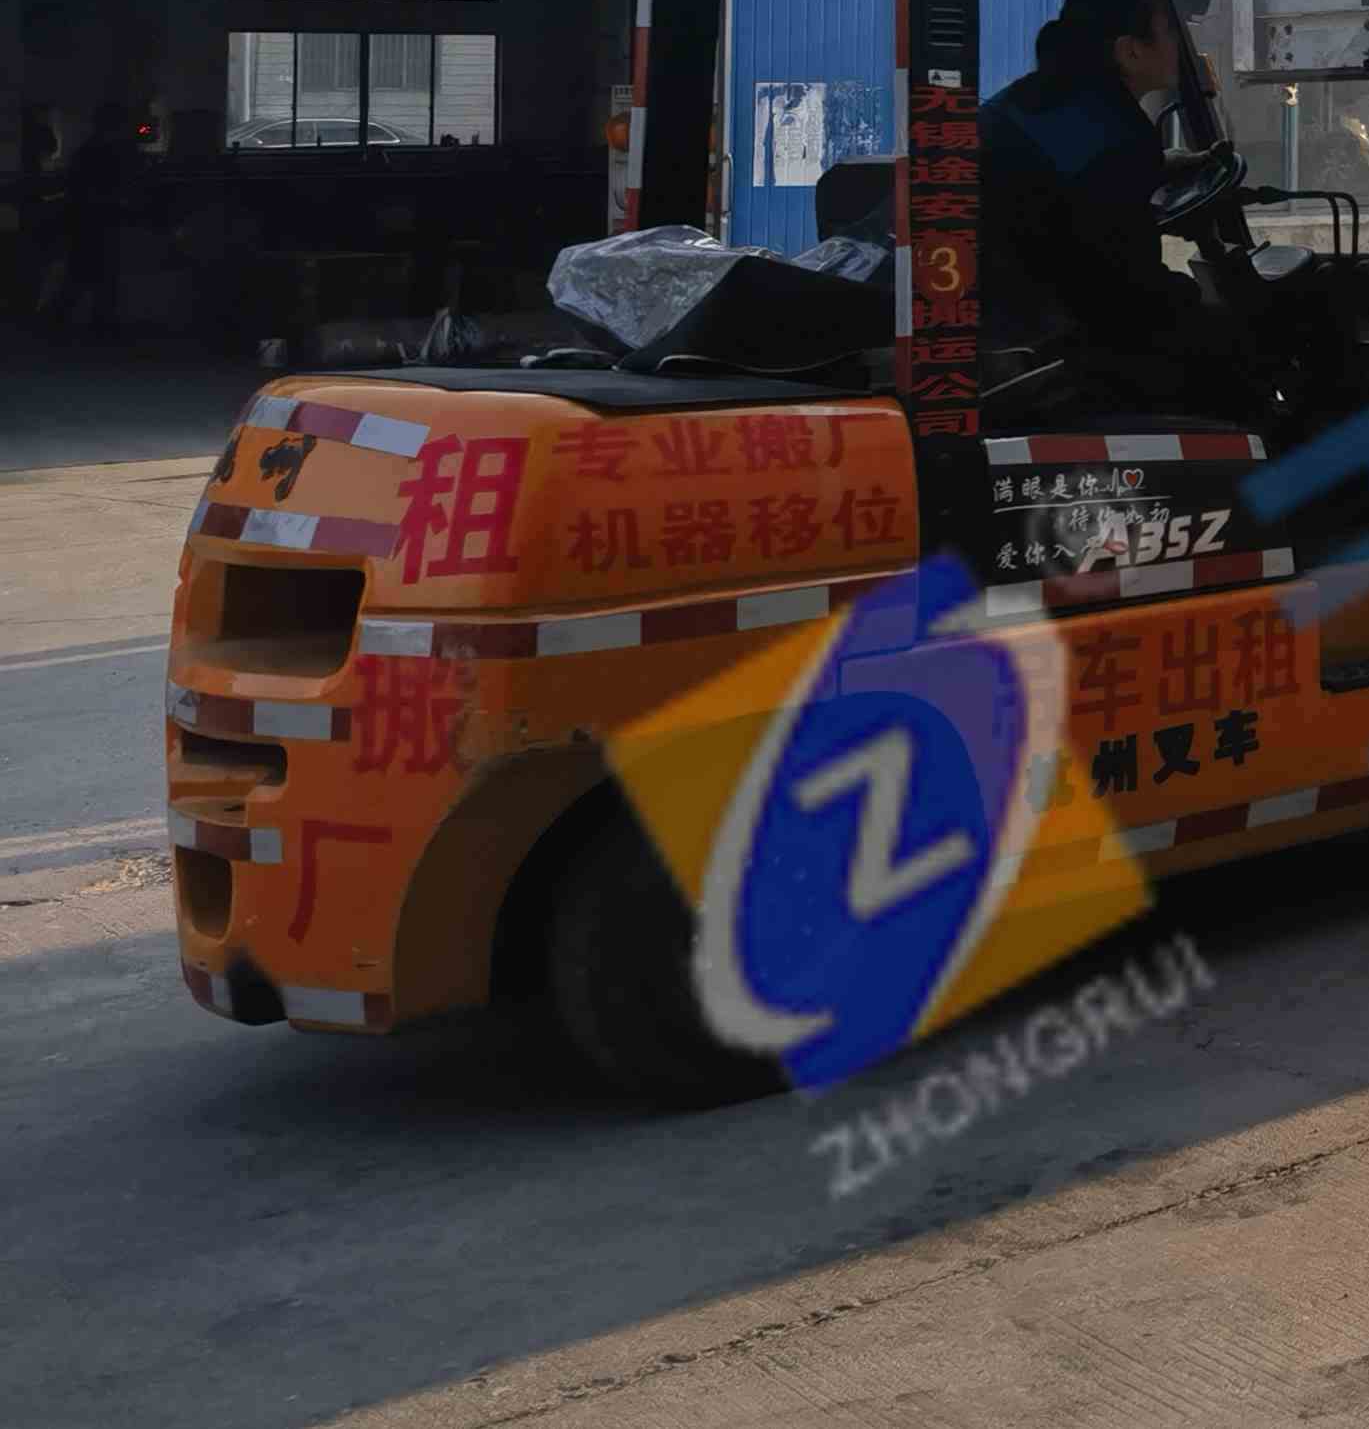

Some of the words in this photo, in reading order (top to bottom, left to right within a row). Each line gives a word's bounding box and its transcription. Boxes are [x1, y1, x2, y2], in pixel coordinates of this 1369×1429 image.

[552, 411, 896, 482] 专业搬厂
[398, 432, 532, 584] 租
[567, 484, 905, 573] 机器移位
